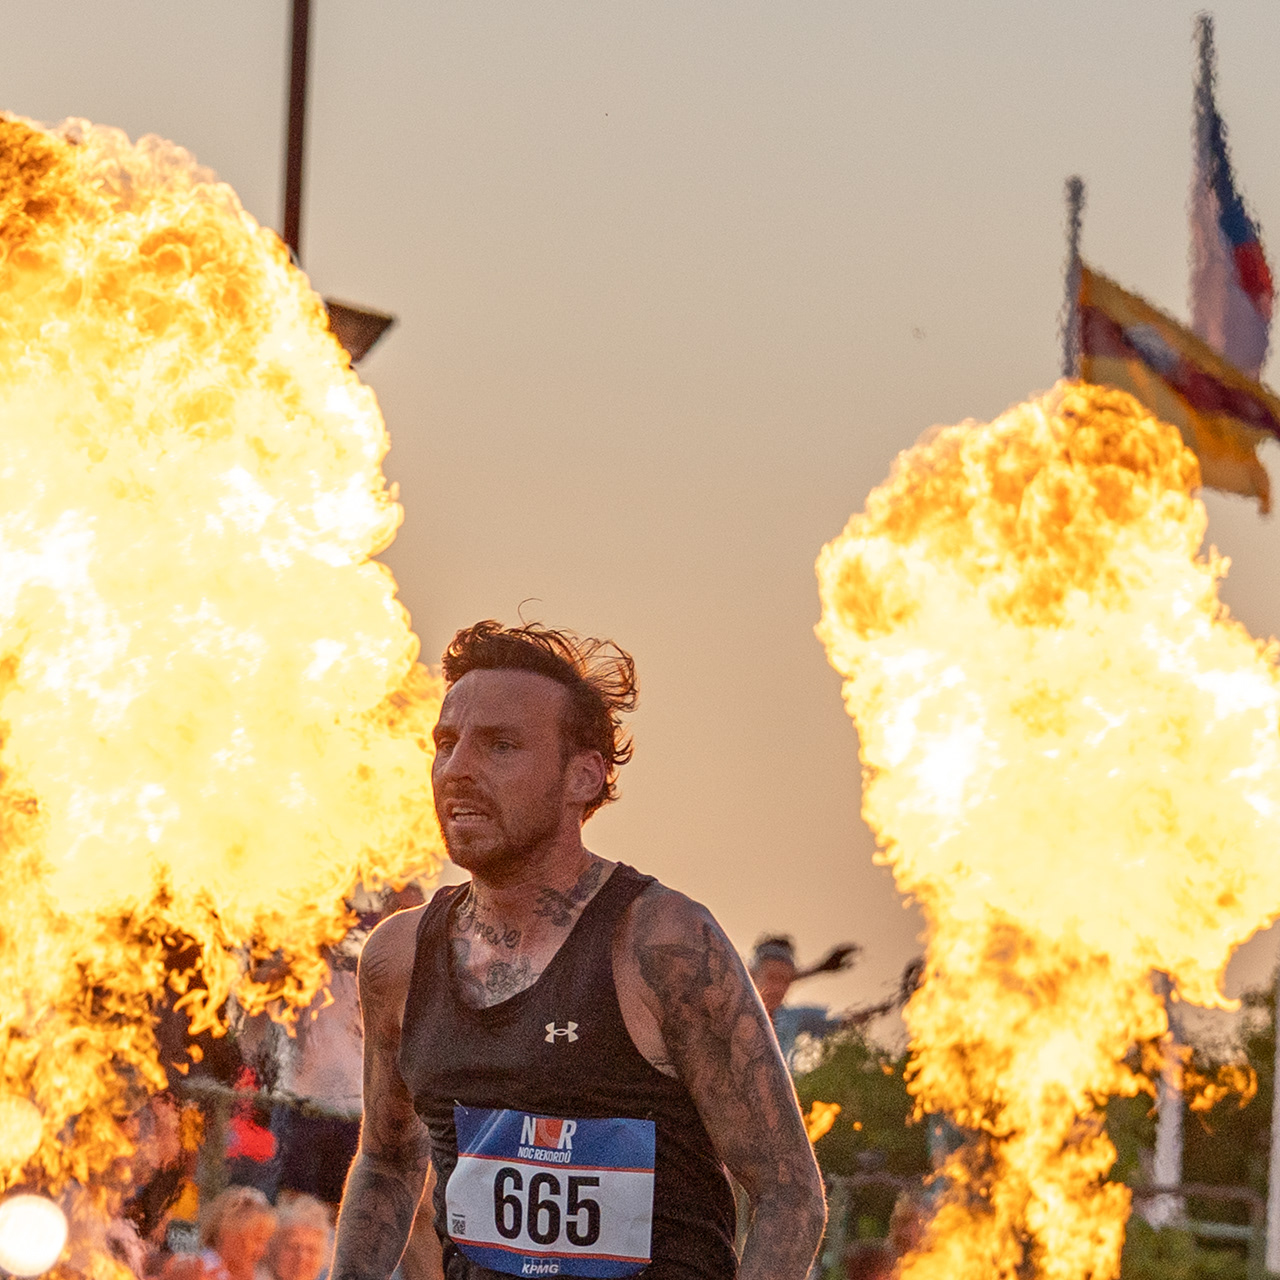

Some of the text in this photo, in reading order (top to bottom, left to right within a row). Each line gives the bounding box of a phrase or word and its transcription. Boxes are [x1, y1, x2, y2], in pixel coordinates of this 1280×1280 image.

[517, 1146, 535, 1159] NOC
[494, 1166, 601, 1247] 665
[521, 1262, 560, 1274] KPMG
